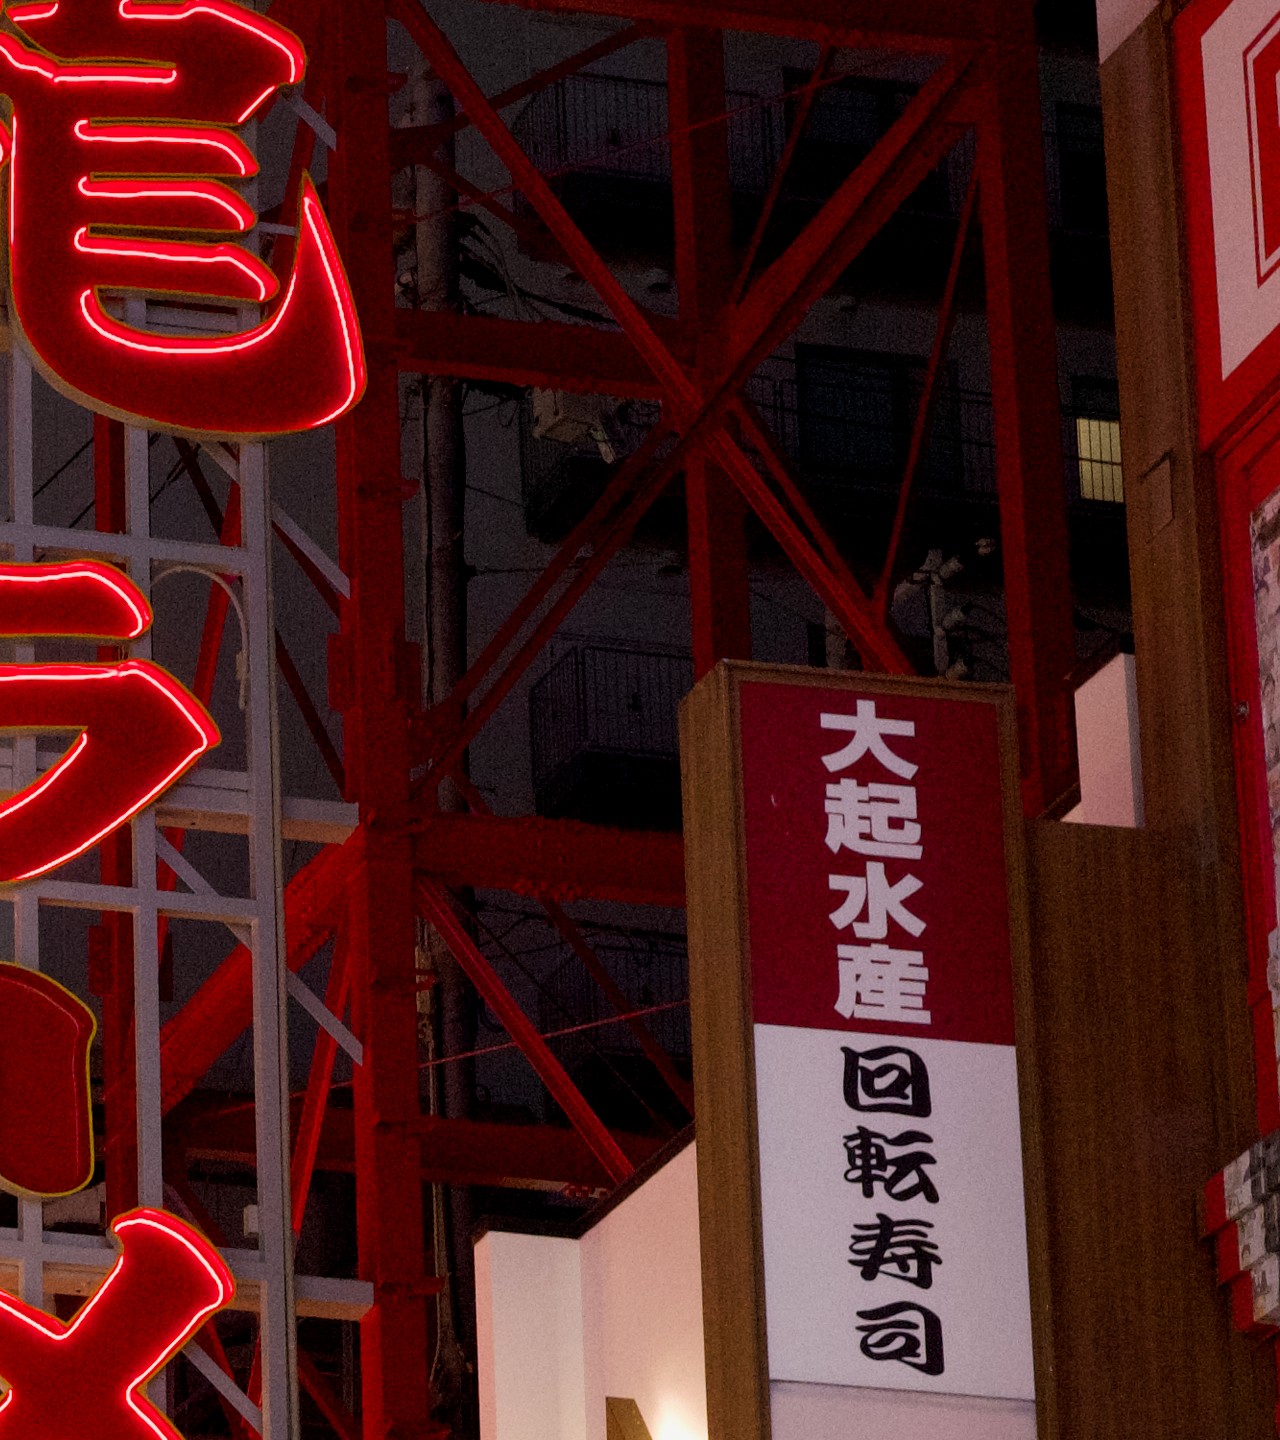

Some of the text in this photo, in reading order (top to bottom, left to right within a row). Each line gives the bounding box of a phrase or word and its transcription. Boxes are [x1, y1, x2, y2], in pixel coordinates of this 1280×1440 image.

[818, 697, 934, 1027] 大起水産
[839, 1042, 947, 1377] 回転寿司
